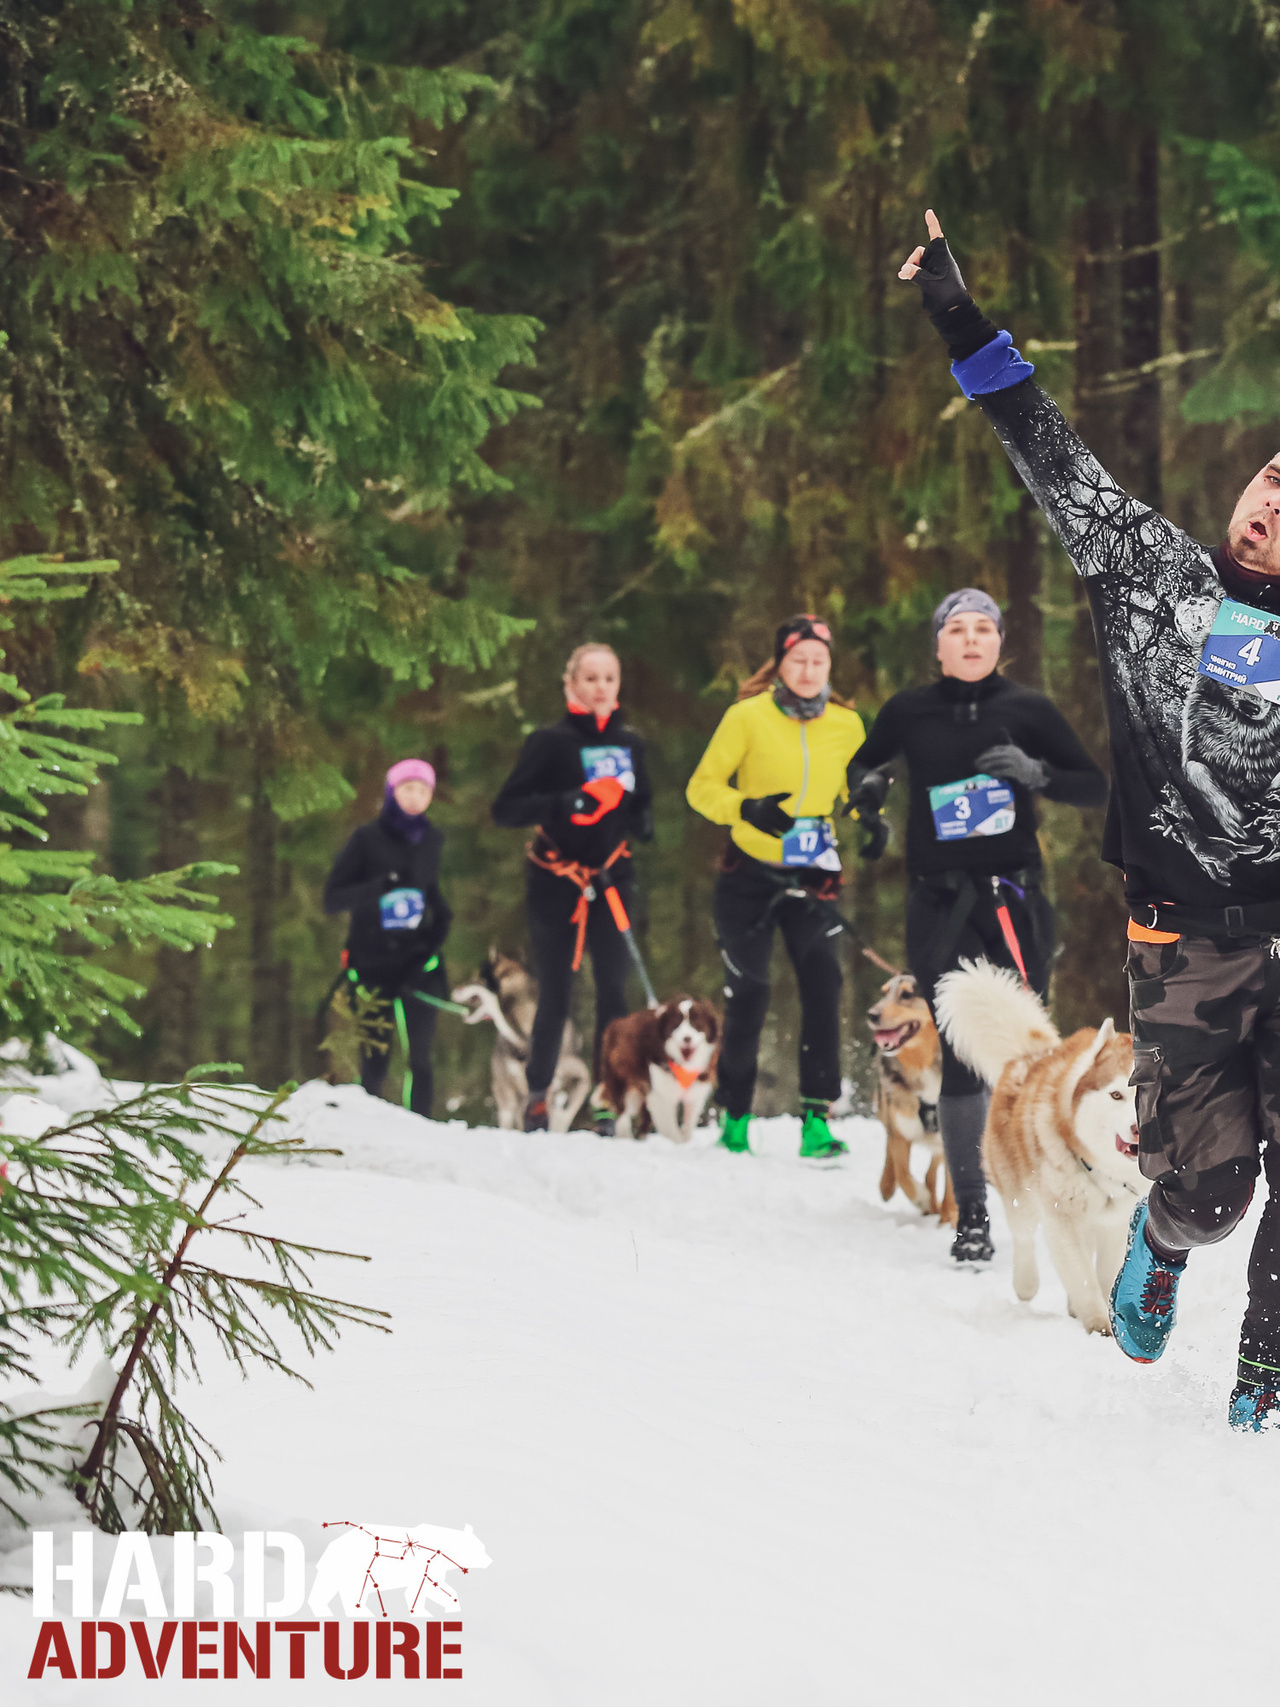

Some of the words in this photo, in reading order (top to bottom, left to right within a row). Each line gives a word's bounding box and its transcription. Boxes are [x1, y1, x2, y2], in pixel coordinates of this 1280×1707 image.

[1230, 611, 1266, 631] HARD
[1237, 637, 1263, 667] 4
[1206, 662, 1248, 685] ДМИТРИЙ
[954, 795, 972, 820] 3
[799, 831, 819, 852] 17
